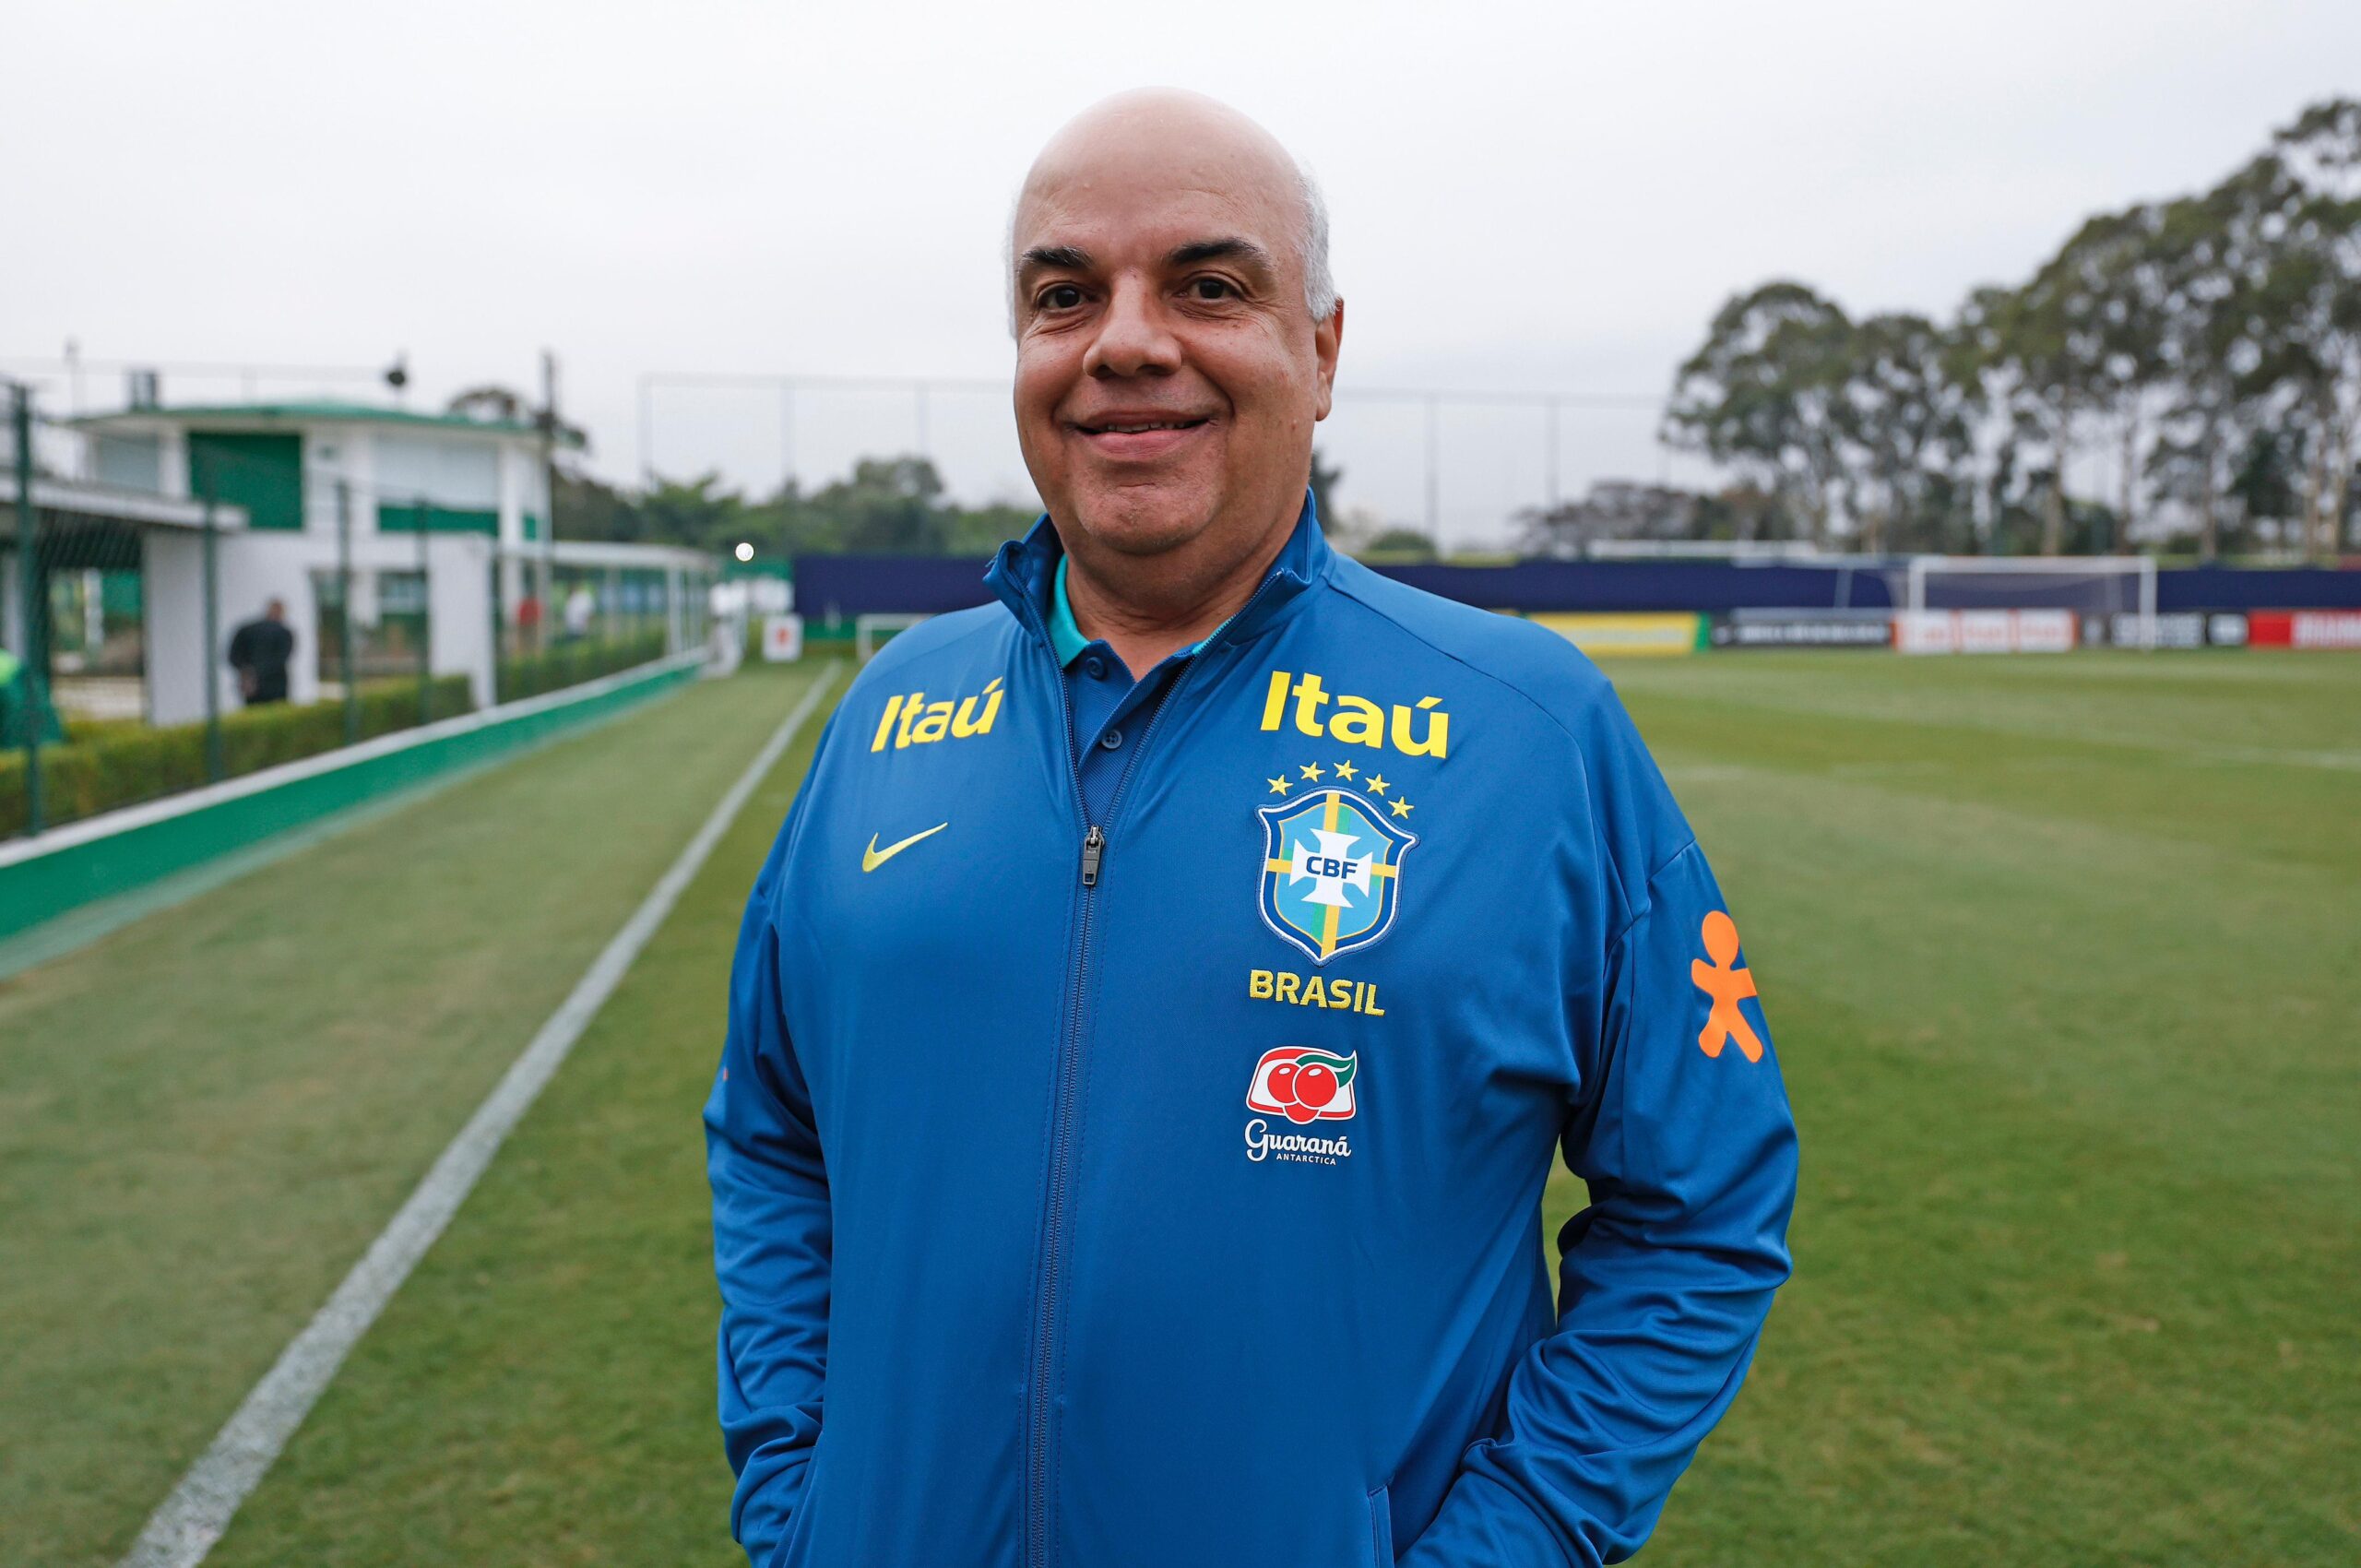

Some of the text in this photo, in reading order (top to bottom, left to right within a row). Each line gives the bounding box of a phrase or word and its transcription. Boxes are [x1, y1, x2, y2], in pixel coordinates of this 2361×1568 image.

[871, 676, 1004, 753] Itaú
[1260, 671, 1450, 759] Itaú
[1306, 856, 1358, 879] CBF
[1250, 969, 1385, 1016] BRASIL
[1244, 1119, 1352, 1162] Guaraná
[1275, 1153, 1336, 1166] ANTARCTICA
